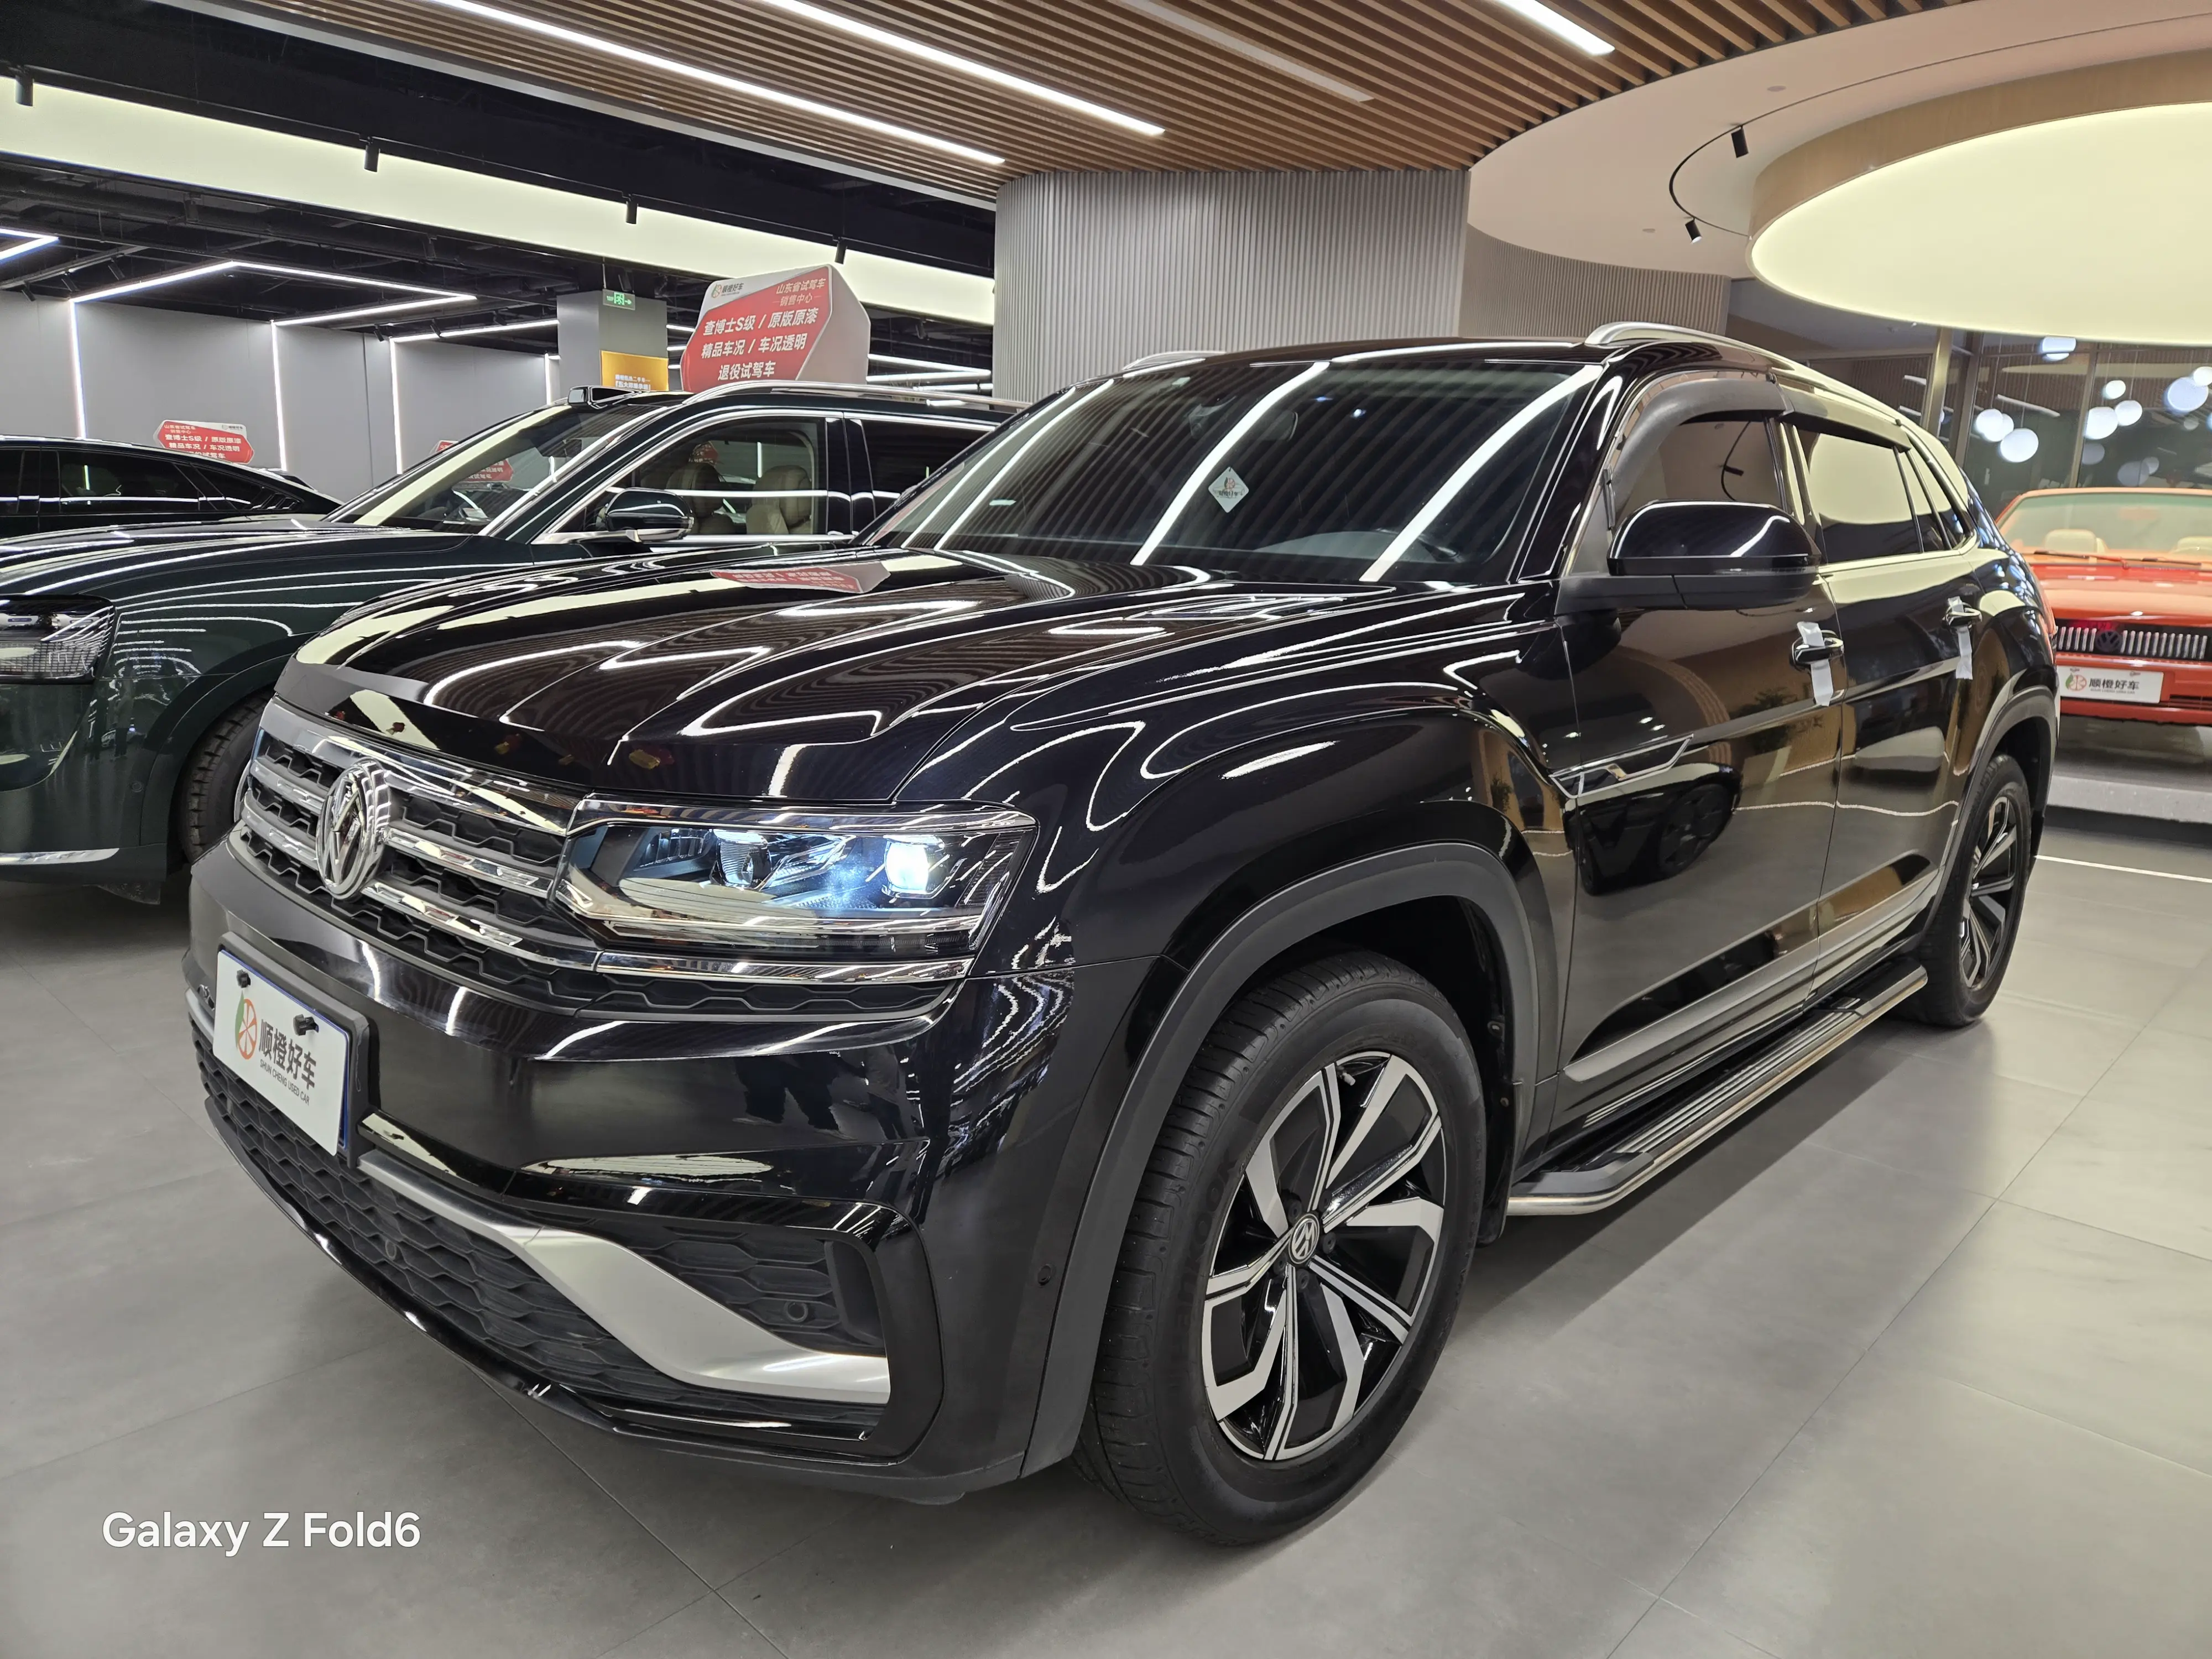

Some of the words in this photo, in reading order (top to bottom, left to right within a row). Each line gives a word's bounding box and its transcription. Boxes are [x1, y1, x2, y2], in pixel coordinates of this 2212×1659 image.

[776, 278, 826, 294] 山东省试驾车
[780, 292, 813, 306] 销售中心
[703, 315, 756, 336] 查博士S级
[768, 307, 818, 328] 原版原漆
[701, 340, 745, 358] 精品车况
[758, 333, 807, 353] 车况透明
[717, 361, 776, 380] 退役试驾车
[259, 1019, 316, 1090] 顺橙好车
[260, 1059, 272, 1074] SHUN
[273, 1068, 287, 1087] CHENG
[288, 1081, 299, 1097] USED
[300, 1091, 310, 1106] CAR
